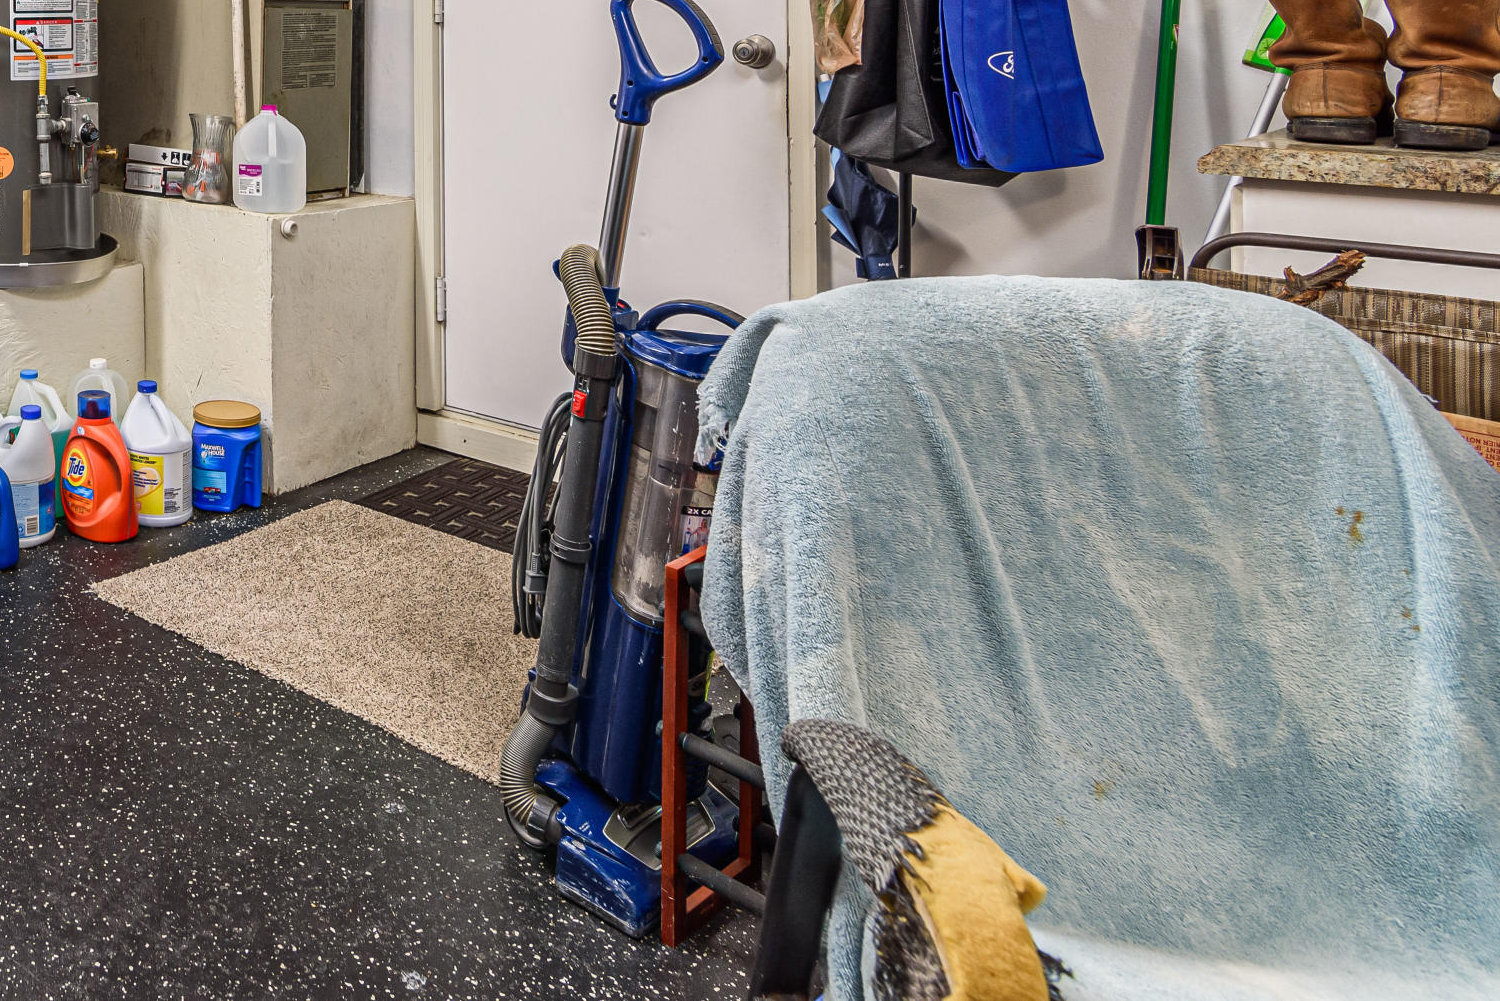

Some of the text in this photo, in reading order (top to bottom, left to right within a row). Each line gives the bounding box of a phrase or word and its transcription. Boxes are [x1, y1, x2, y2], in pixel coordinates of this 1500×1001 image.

[201, 443, 224, 451] MAXWELL
[208, 449, 225, 457] HOUSE
[67, 457, 86, 476] Tide
